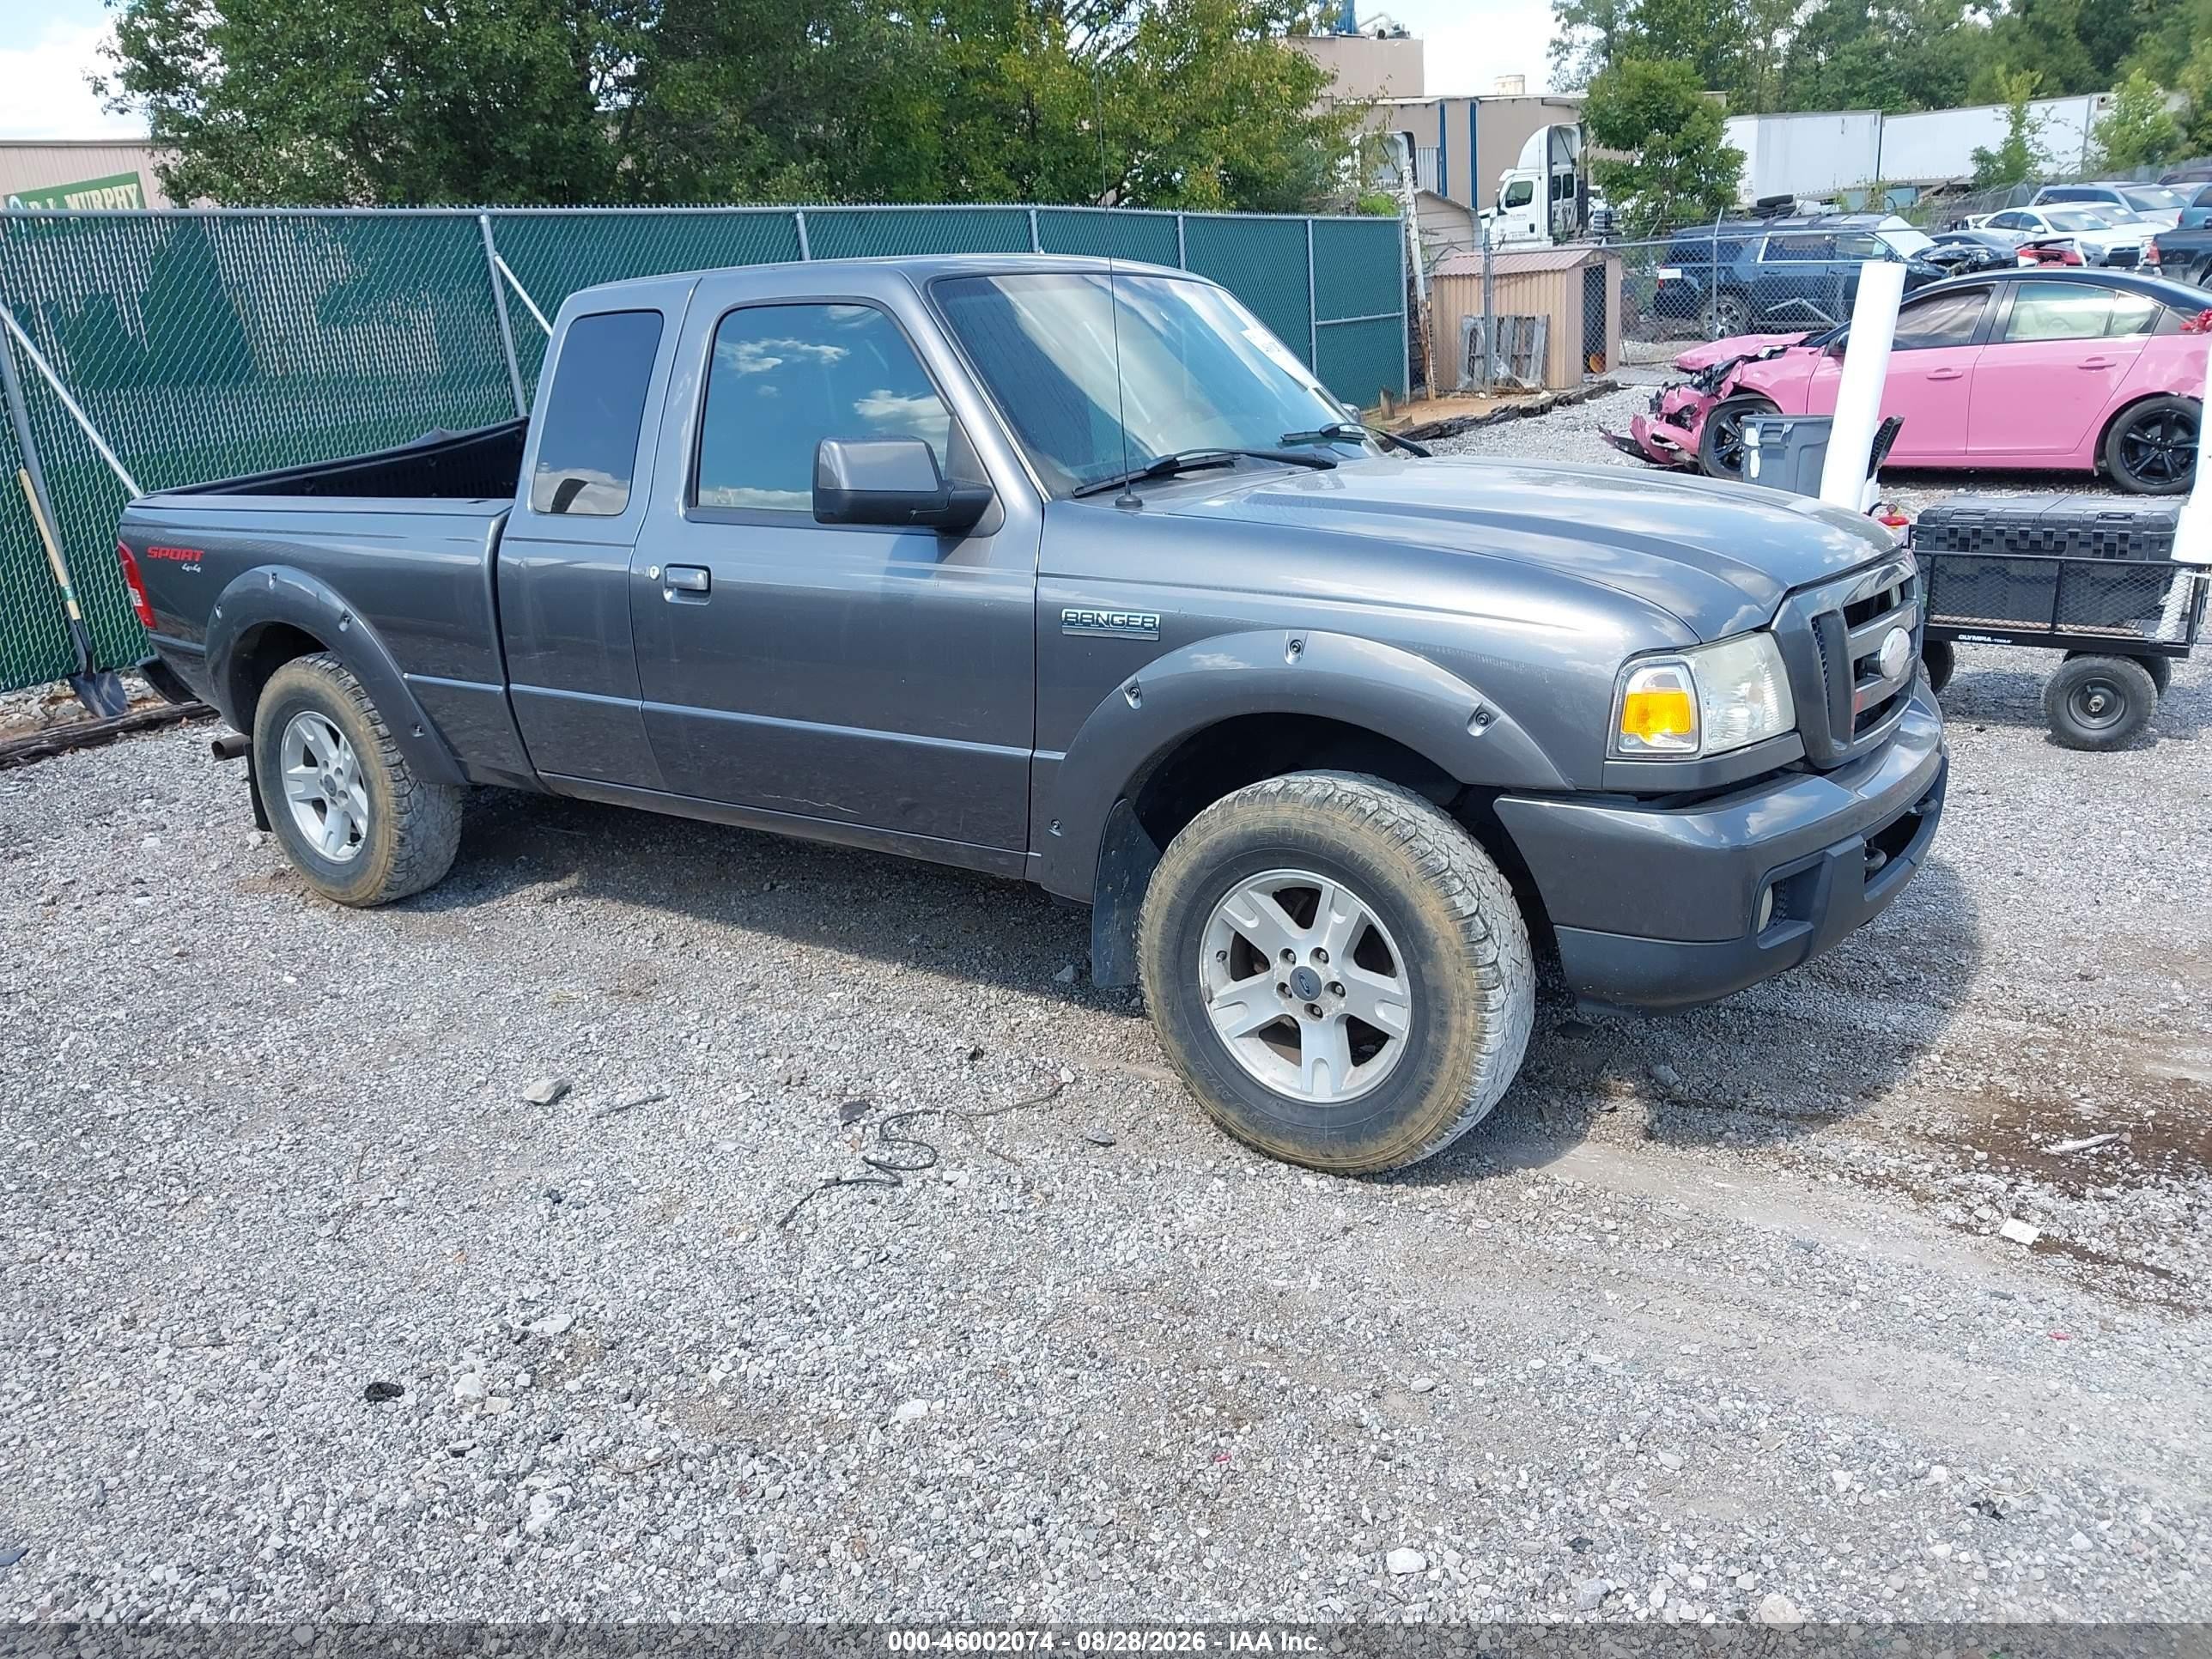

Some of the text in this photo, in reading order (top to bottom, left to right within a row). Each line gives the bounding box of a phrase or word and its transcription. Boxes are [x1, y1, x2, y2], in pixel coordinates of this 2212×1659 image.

[64, 183, 137, 210] MURPHY
[147, 546, 204, 562] SPORT
[1064, 611, 1157, 630] RANGER
